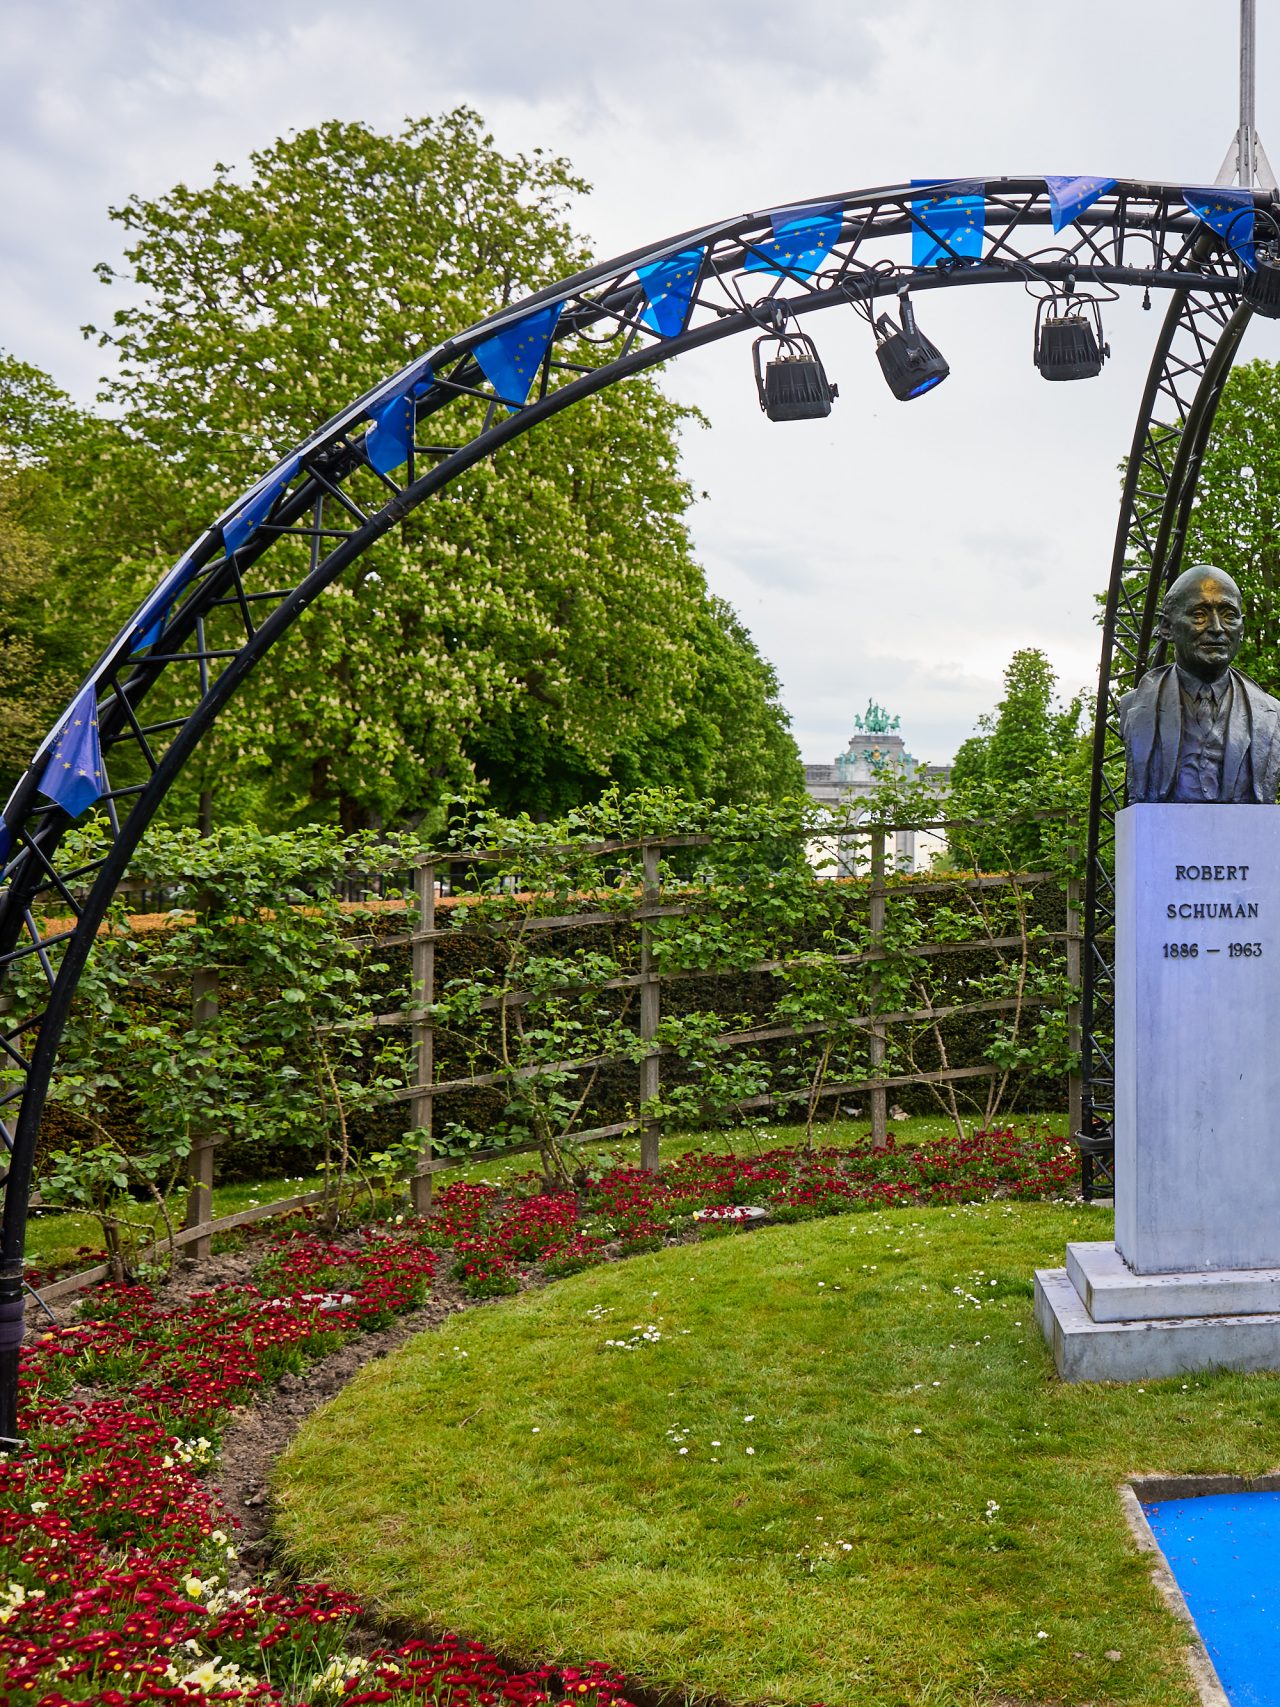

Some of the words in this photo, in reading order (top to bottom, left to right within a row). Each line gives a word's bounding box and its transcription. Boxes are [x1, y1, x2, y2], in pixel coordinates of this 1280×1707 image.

[1175, 865, 1249, 880] ROBERT
[1167, 903, 1259, 919] SCHUMAN
[1162, 943, 1199, 958] 1886
[1228, 942, 1263, 957] 1963
